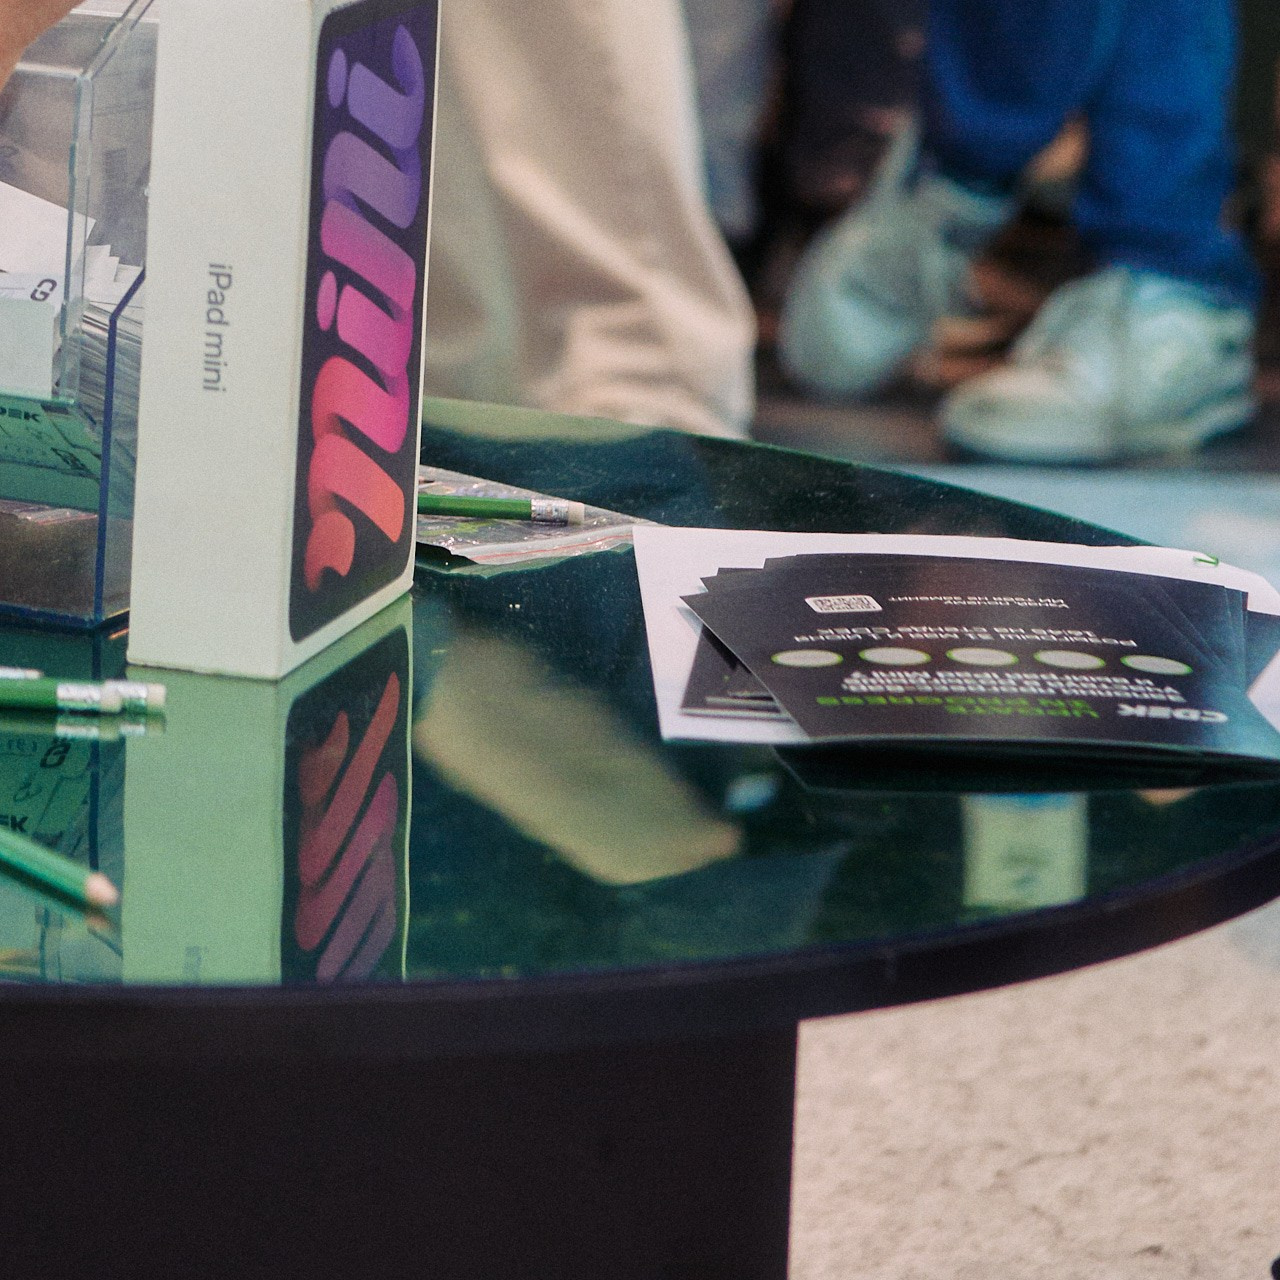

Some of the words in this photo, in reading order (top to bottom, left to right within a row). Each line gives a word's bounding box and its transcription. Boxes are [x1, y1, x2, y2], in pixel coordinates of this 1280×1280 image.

[205, 262, 234, 326] iPad
[200, 331, 230, 393] mini
[1117, 703, 1228, 723] CDEK
